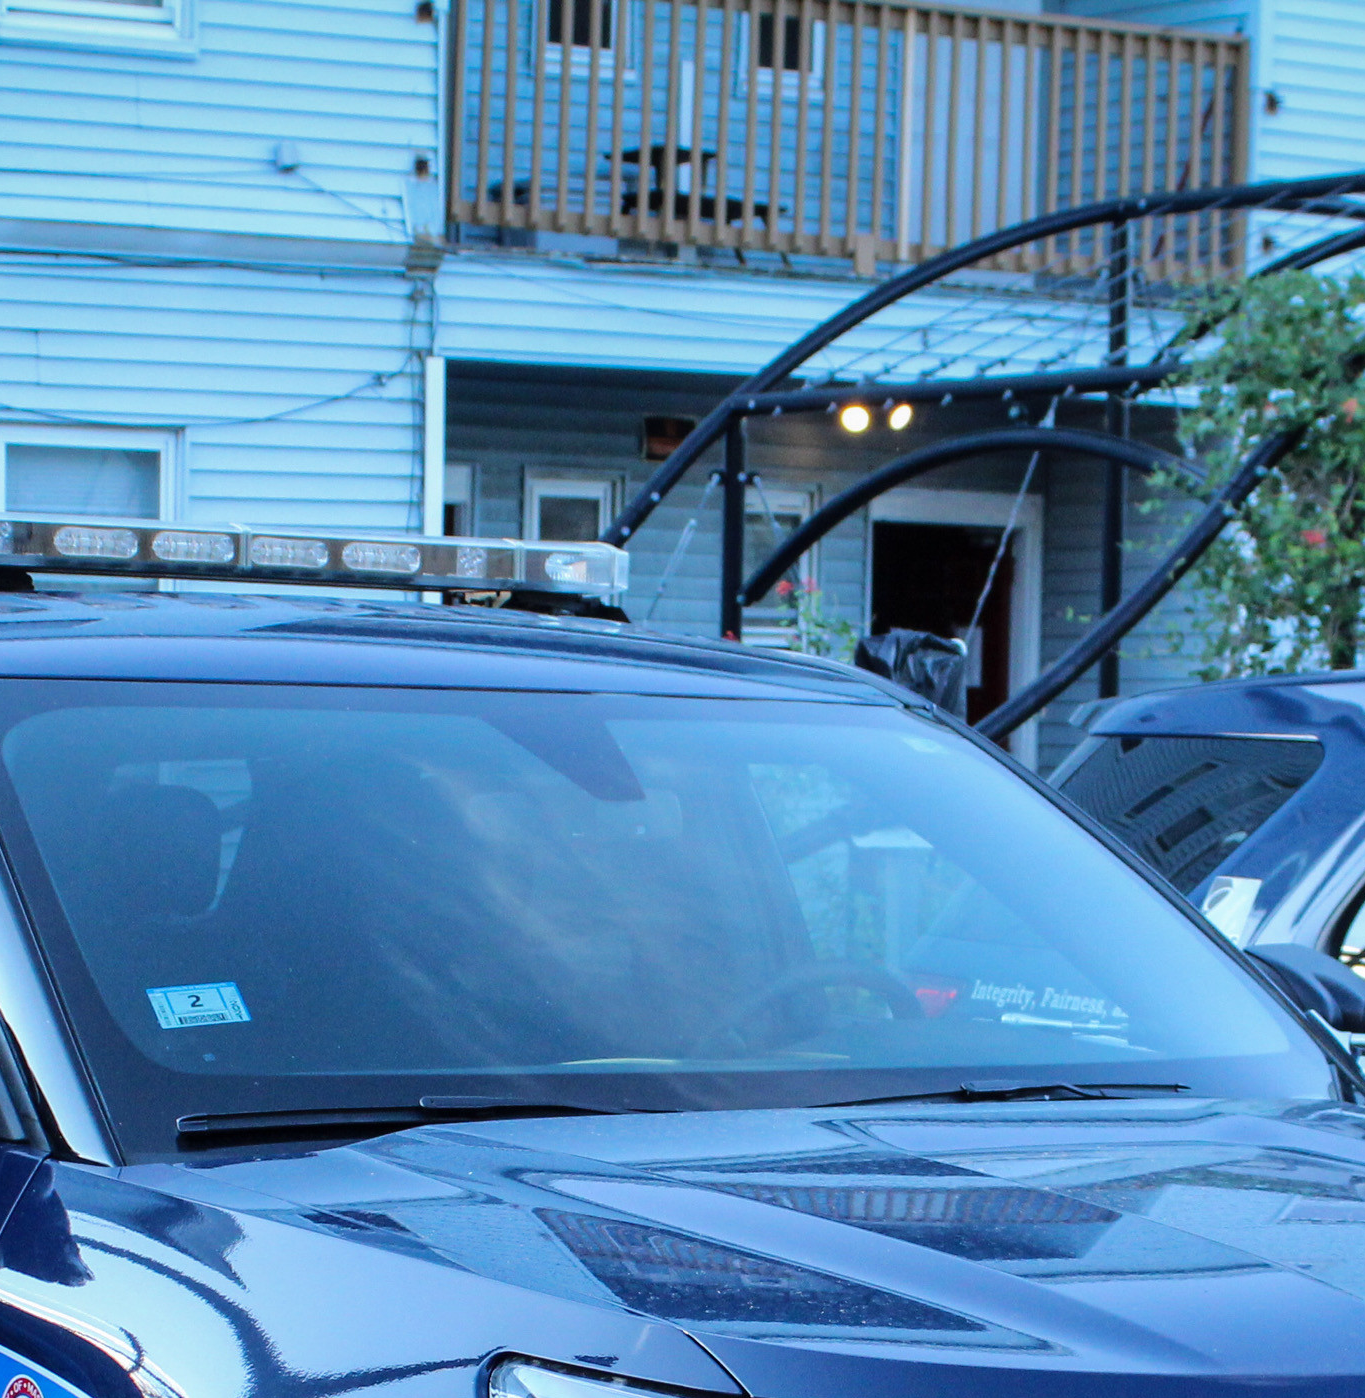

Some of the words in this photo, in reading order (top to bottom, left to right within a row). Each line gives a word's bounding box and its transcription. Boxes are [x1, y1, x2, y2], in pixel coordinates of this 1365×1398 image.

[187, 994, 204, 1008] 2
[971, 979, 1035, 1010] Integrity,
[1040, 986, 1107, 1018] Fairness,
[13, 1380, 23, 1393] OF
